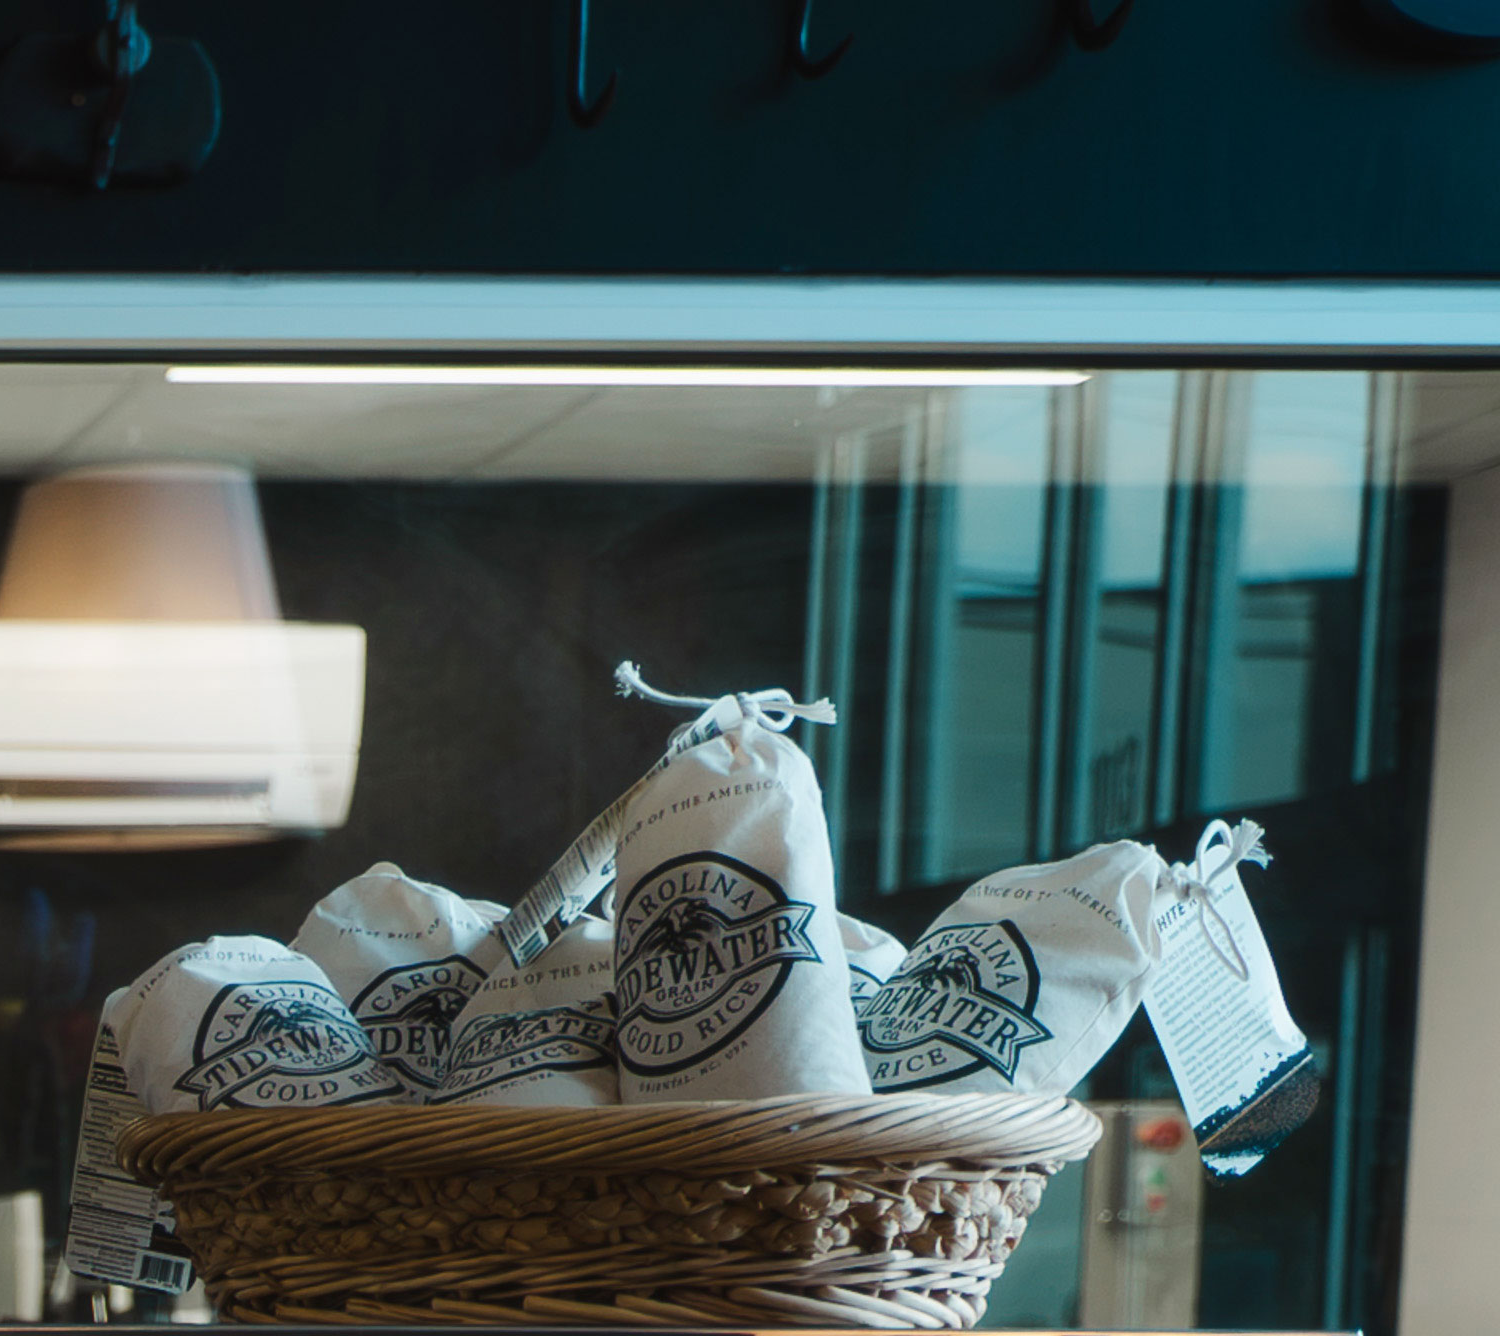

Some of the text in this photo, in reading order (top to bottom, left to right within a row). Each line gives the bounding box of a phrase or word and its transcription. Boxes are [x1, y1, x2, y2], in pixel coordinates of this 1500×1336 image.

[671, 793, 701, 815] THE
[618, 868, 757, 955] CAROLINA
[523, 971, 545, 986] OF
[550, 963, 582, 981] THE
[619, 913, 799, 1013] IDEWATER
[655, 977, 715, 1003] GRAIN
[625, 978, 762, 1056] GOLD RICE
[877, 1016, 925, 1034] GRAIN
[509, 1042, 581, 1069] RICE
[873, 1047, 948, 1080] RICE
[255, 1078, 340, 1102] GOLD
